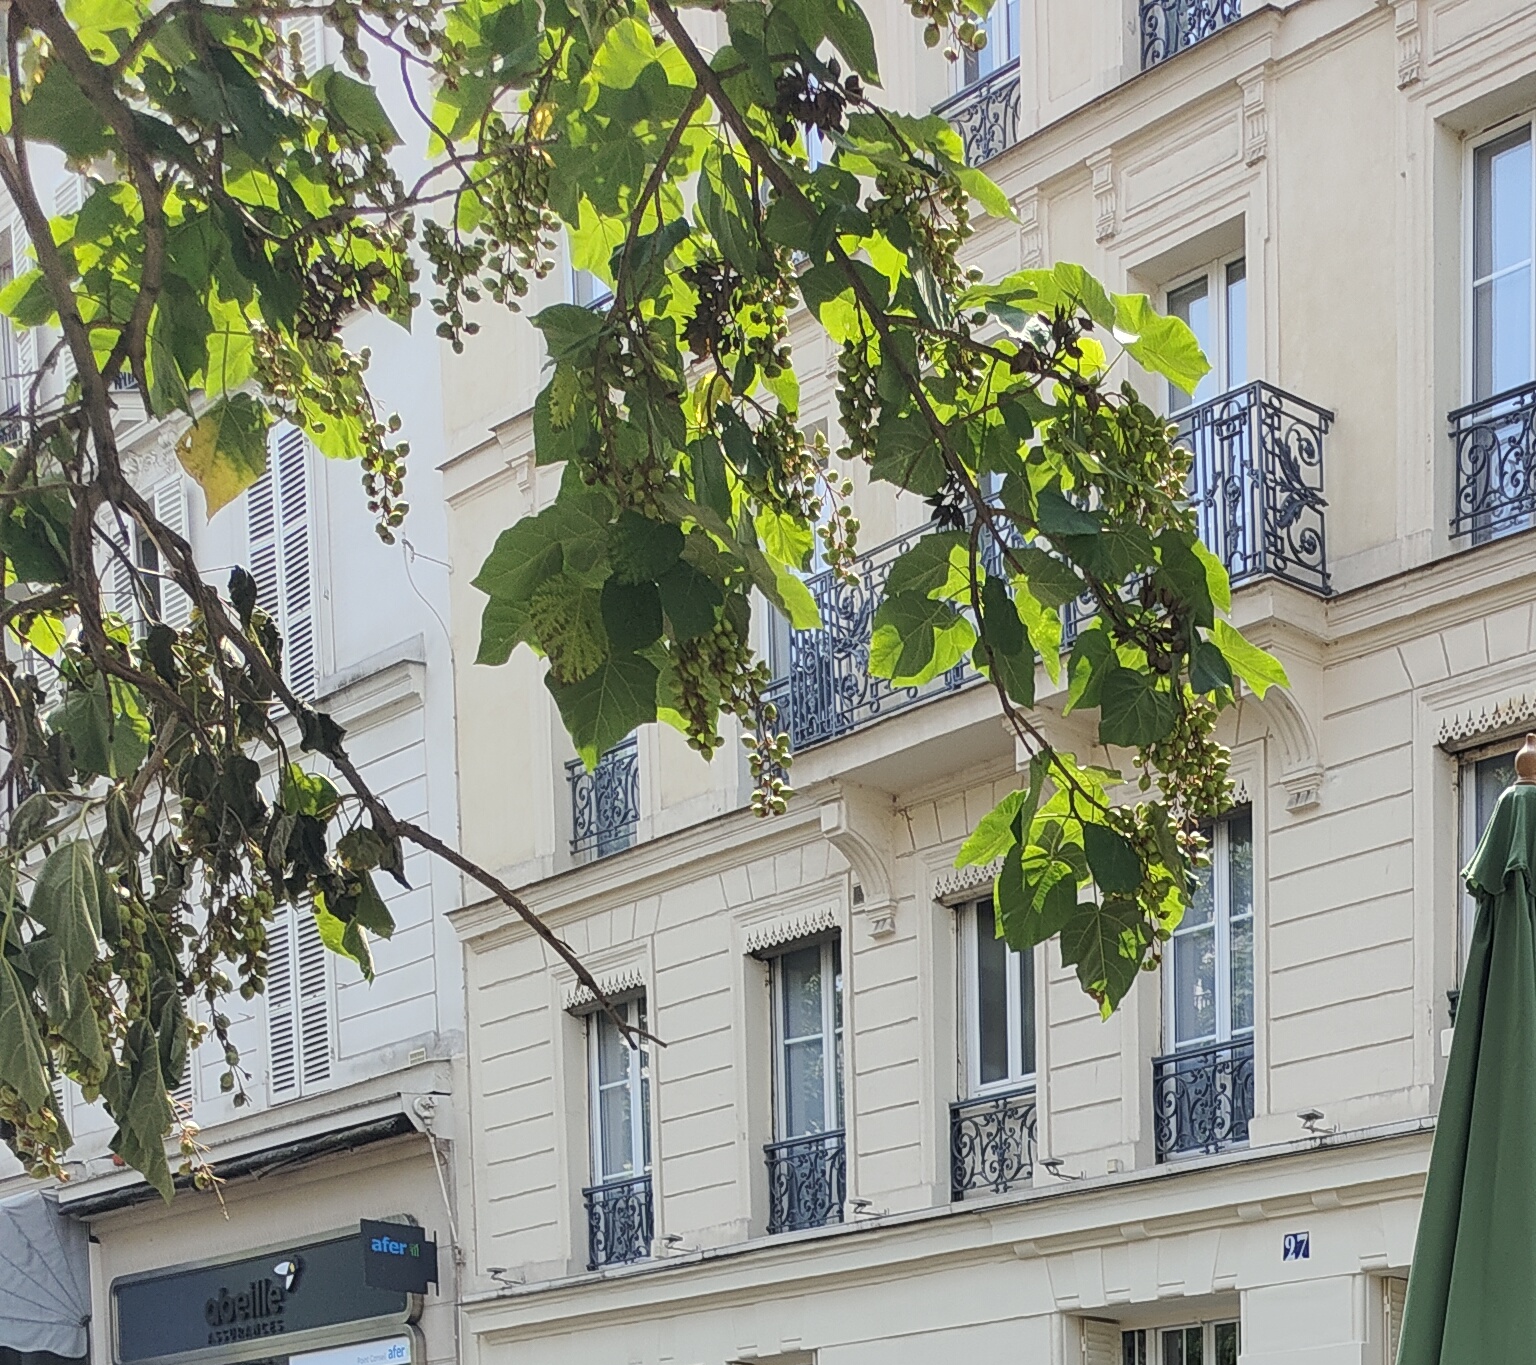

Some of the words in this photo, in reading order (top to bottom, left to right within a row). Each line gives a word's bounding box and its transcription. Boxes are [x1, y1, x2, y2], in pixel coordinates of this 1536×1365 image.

[371, 1236, 408, 1256] afer
[1284, 1233, 1309, 1261] 27
[205, 1278, 285, 1328] abeille
[388, 1344, 406, 1360] afer
